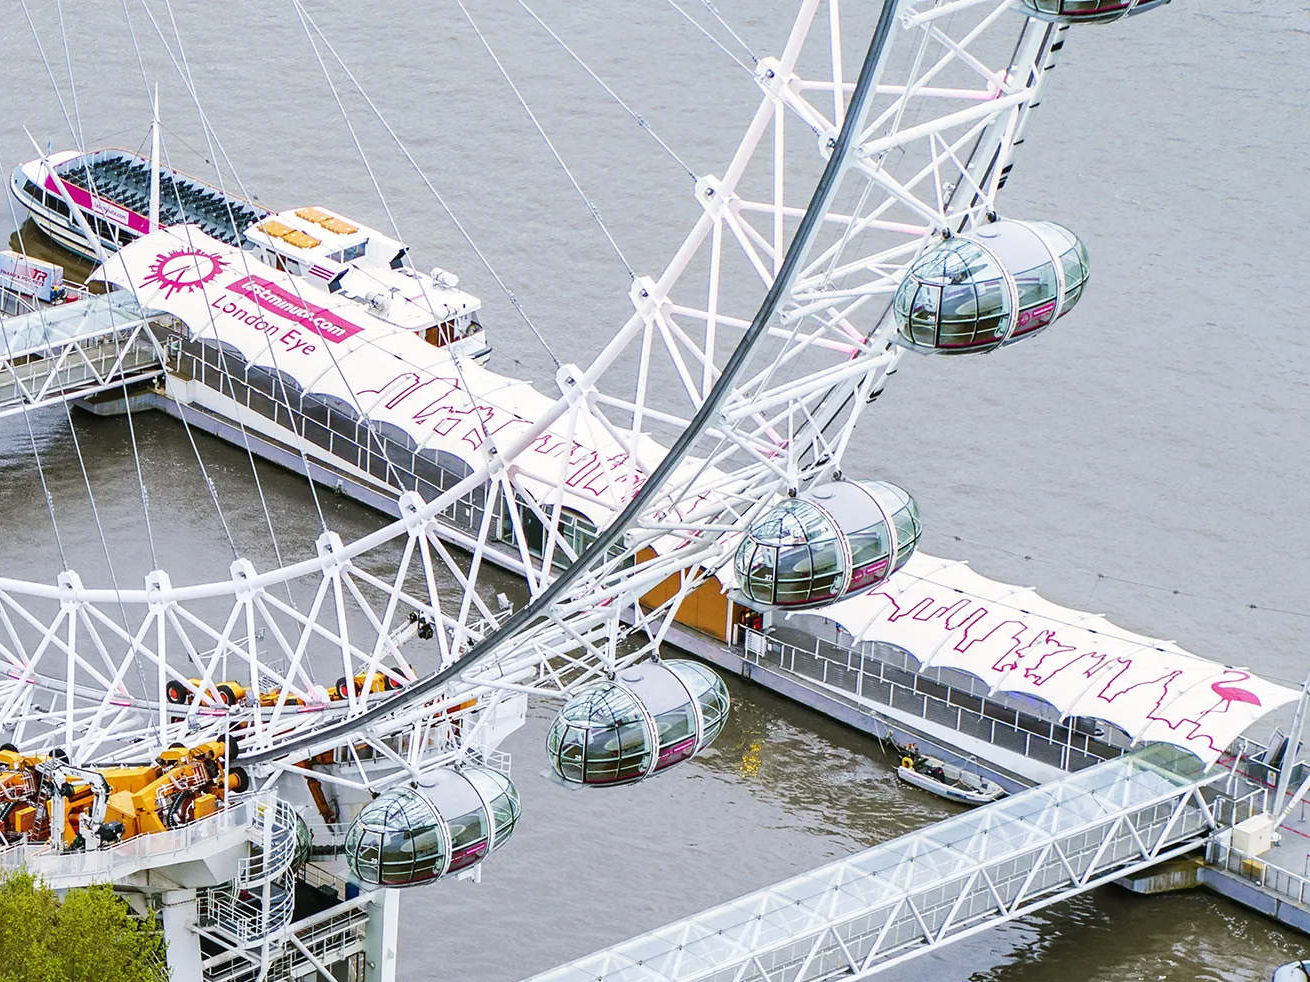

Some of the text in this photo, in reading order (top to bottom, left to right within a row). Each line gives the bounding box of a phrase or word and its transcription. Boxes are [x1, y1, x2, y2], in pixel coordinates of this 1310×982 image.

[33, 268, 48, 282] TR
[211, 294, 316, 356] London Eye
